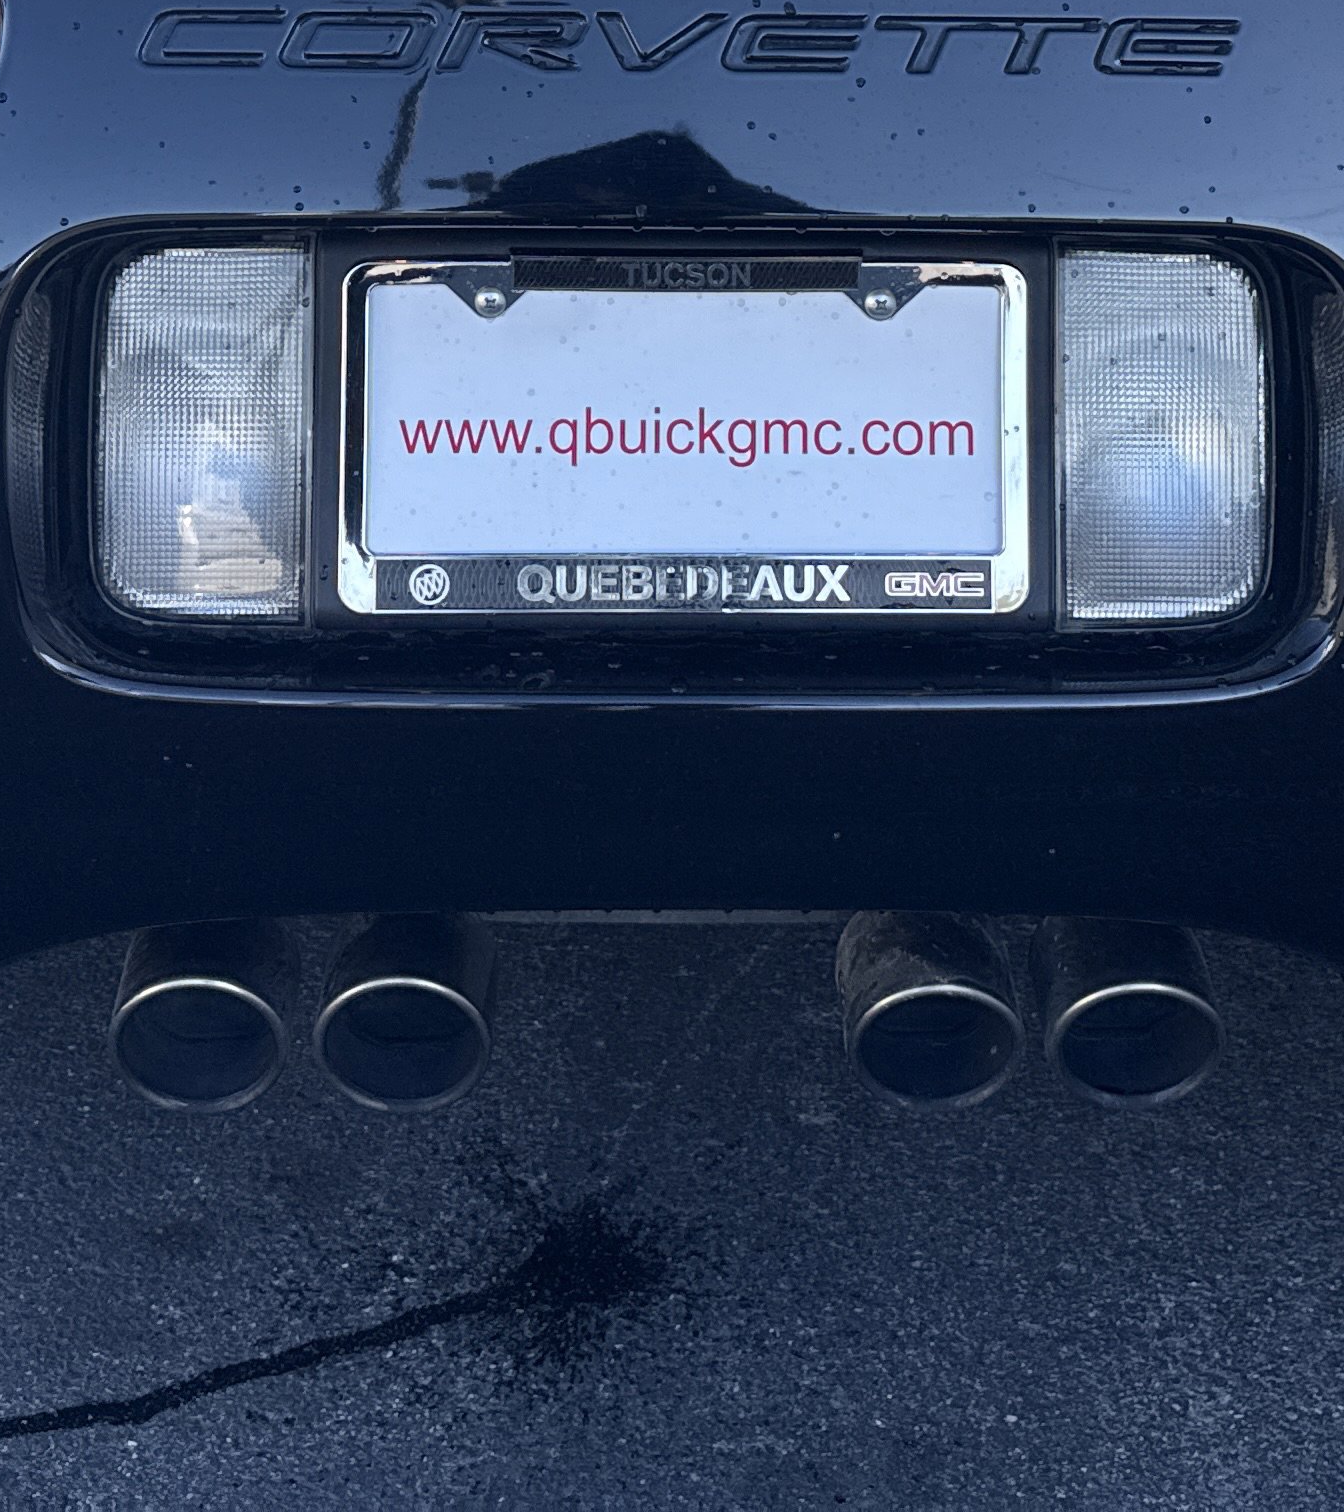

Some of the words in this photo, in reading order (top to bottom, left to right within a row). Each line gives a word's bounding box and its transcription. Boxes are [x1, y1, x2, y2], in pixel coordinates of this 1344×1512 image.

[137, 7, 1242, 78] CORVETTE
[620, 262, 753, 288] TUCSON
[398, 406, 976, 468] www.qbuickgmc.com
[516, 564, 852, 605] QUEBEDEAUX
[884, 571, 987, 598] GMC
